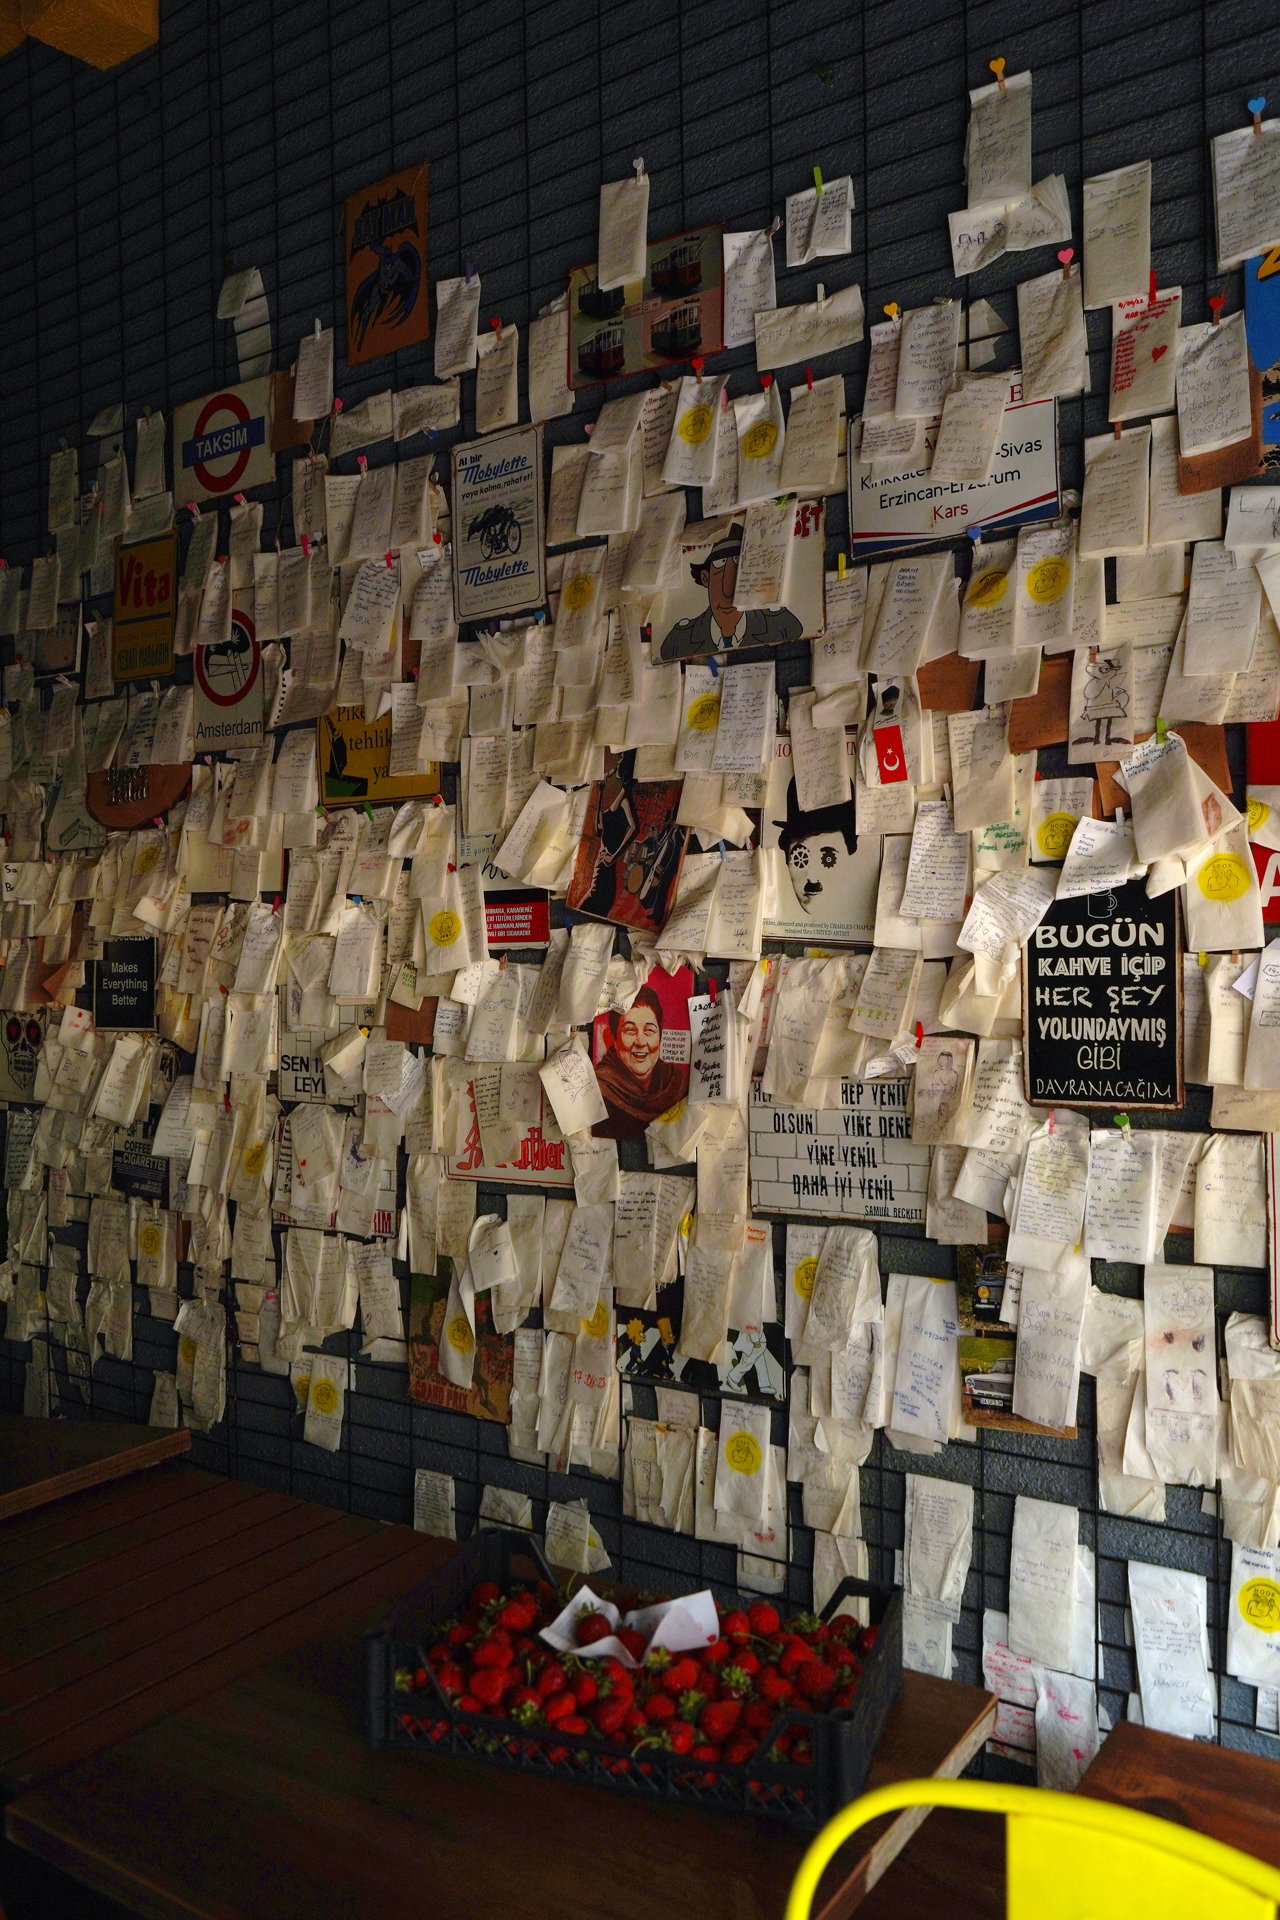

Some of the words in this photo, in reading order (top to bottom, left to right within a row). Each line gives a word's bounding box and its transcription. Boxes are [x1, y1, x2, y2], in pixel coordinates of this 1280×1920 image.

[196, 427, 247, 459] TAKSİM
[459, 457, 467, 467] Al
[470, 454, 483, 464] bir
[459, 456, 532, 485] Mobylette
[933, 502, 969, 522] Kars
[119, 555, 170, 608] Vita
[460, 560, 534, 587] Mobylette
[196, 719, 264, 739] Amsterdam
[1035, 917, 1165, 949] BUGÜN
[111, 962, 139, 973] Makes
[1038, 956, 1112, 977] KAHVE
[1121, 952, 1166, 982] İÇİP
[102, 978, 148, 992] Everything
[112, 994, 138, 1006] Better
[1035, 985, 1093, 1009] HER
[1106, 984, 1166, 1014] ŞEY
[1037, 1016, 1167, 1048] YOLUNDAYMIŞ
[281, 1054, 309, 1073] SEN
[1076, 1042, 1121, 1071] GİBİ
[841, 1083, 864, 1105] HEP
[872, 1079, 910, 1107] YENİL
[1036, 1078, 1172, 1099] DAVRANACAĞIM
[773, 1112, 813, 1135] OLSUN
[843, 1109, 872, 1137] YİNE
[124, 1140, 151, 1155] COFFEE
[807, 1139, 836, 1166] YİNE
[842, 1141, 878, 1168] YENİL
[123, 1152, 167, 1171] CIGARETTES
[793, 1174, 828, 1197] DAHA
[835, 1171, 852, 1198] İYİ
[859, 1174, 895, 1202] YENİL
[864, 1205, 890, 1218] SAMUEL
[893, 1207, 923, 1220] BECKETT
